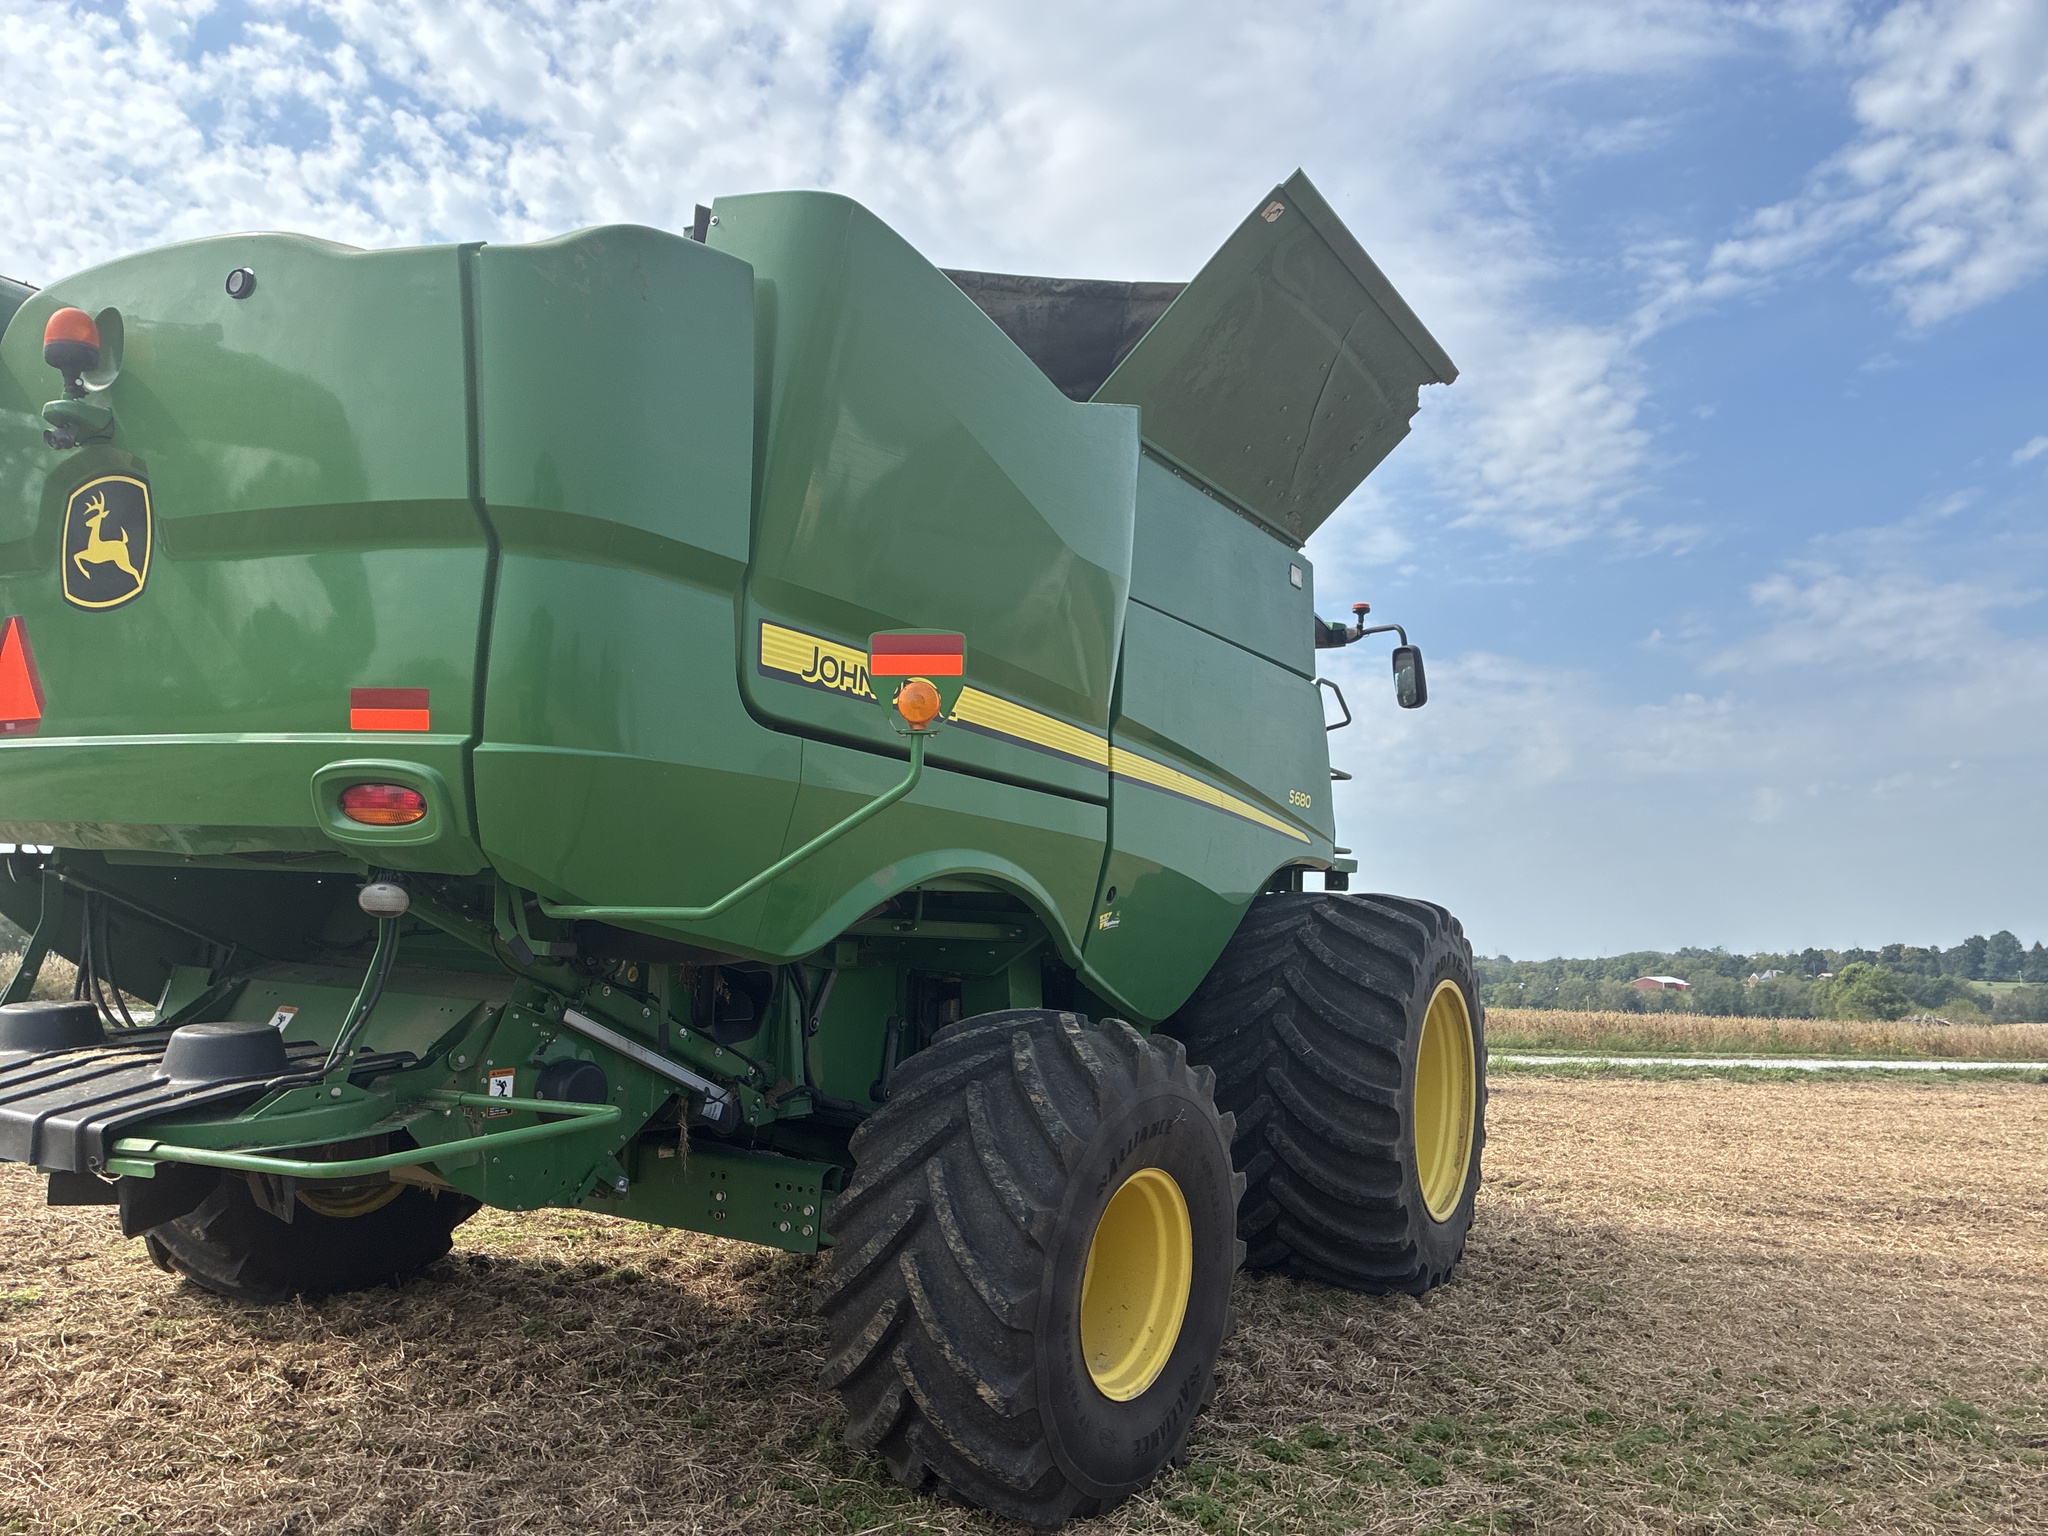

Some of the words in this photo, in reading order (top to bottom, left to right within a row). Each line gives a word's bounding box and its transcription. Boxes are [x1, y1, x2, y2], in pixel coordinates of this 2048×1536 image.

[1288, 789, 1312, 809] S680
[1108, 1119, 1175, 1183] ALLIANCE
[1134, 1378, 1190, 1457] ALLIANCE
